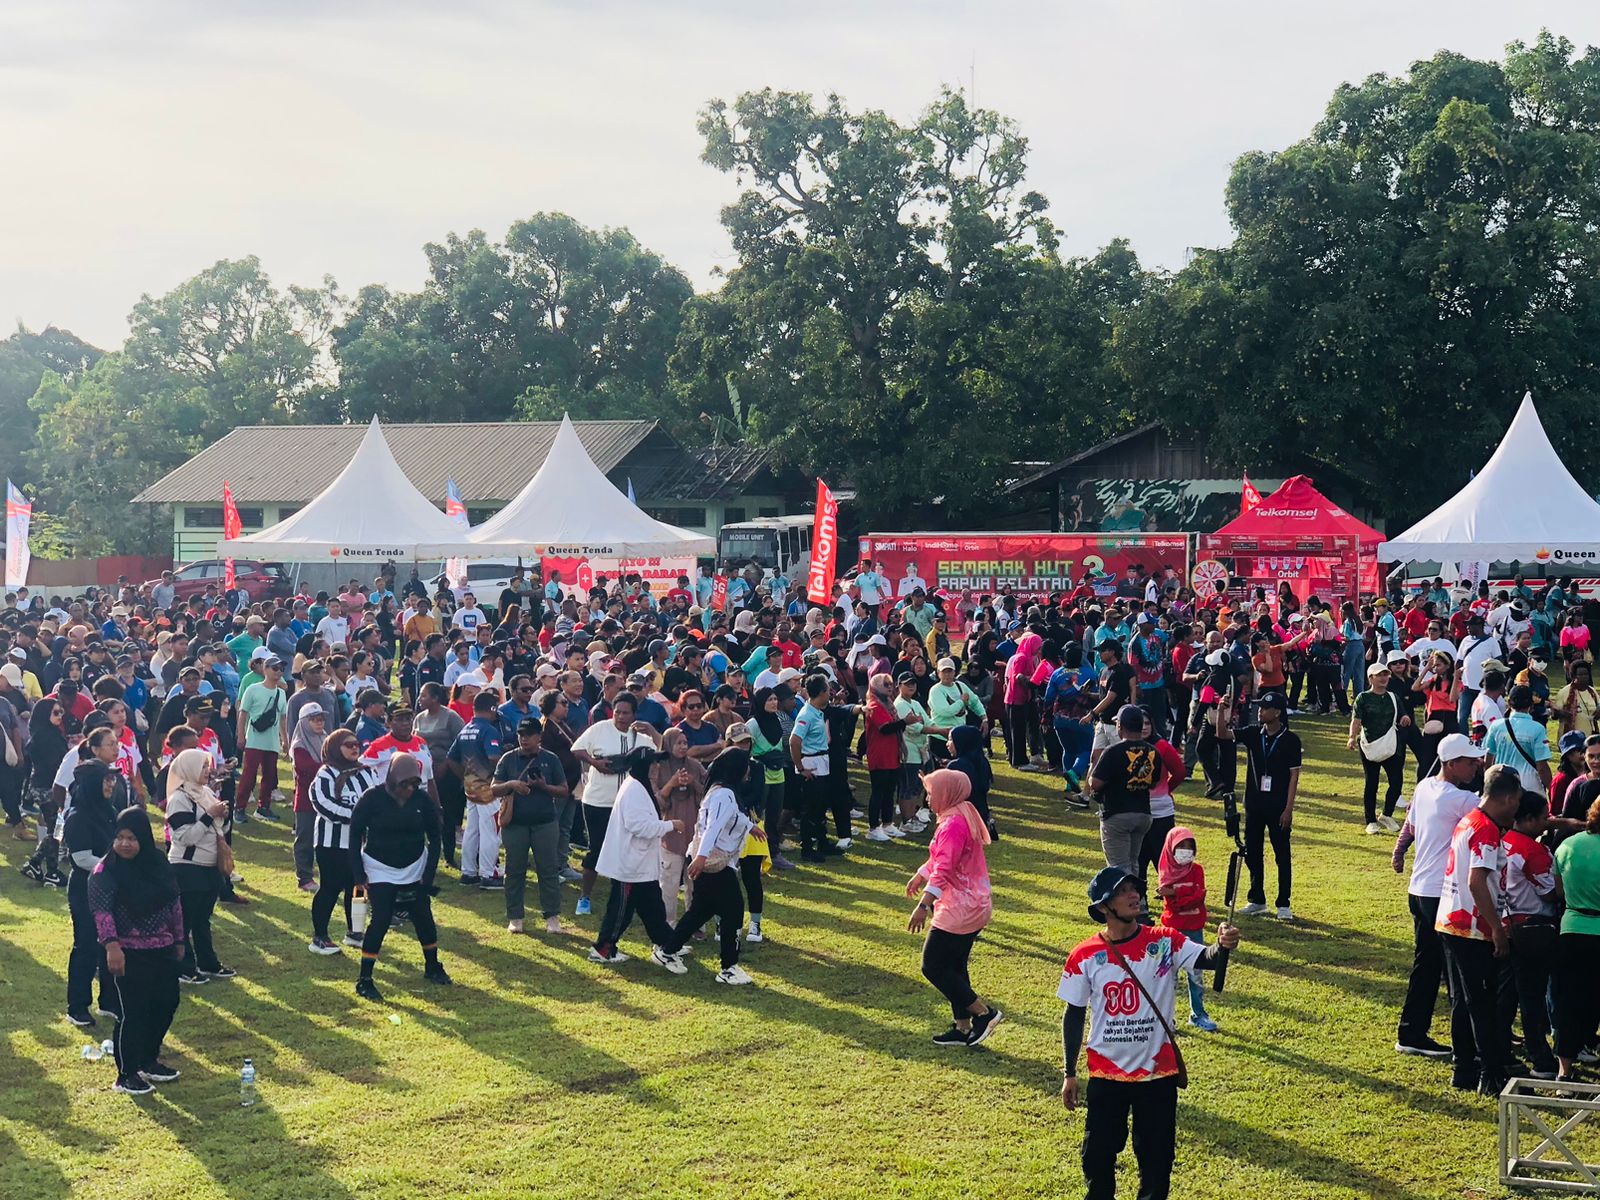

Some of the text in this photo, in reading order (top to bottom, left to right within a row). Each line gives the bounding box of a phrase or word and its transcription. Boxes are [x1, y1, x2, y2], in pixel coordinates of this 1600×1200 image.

[1255, 507, 1318, 517] Telkomsel
[809, 487, 835, 598] Telkomse
[343, 548, 404, 556] Queen Tenda
[548, 546, 613, 555] Queen Tenda
[1554, 549, 1596, 559] Queen
[938, 560, 1027, 576] SEMARAK
[1034, 560, 1074, 576] HUT
[1277, 570, 1299, 578] Orbit
[938, 577, 1072, 591] PAPUA SELATAN
[1103, 978, 1140, 1017] 80
